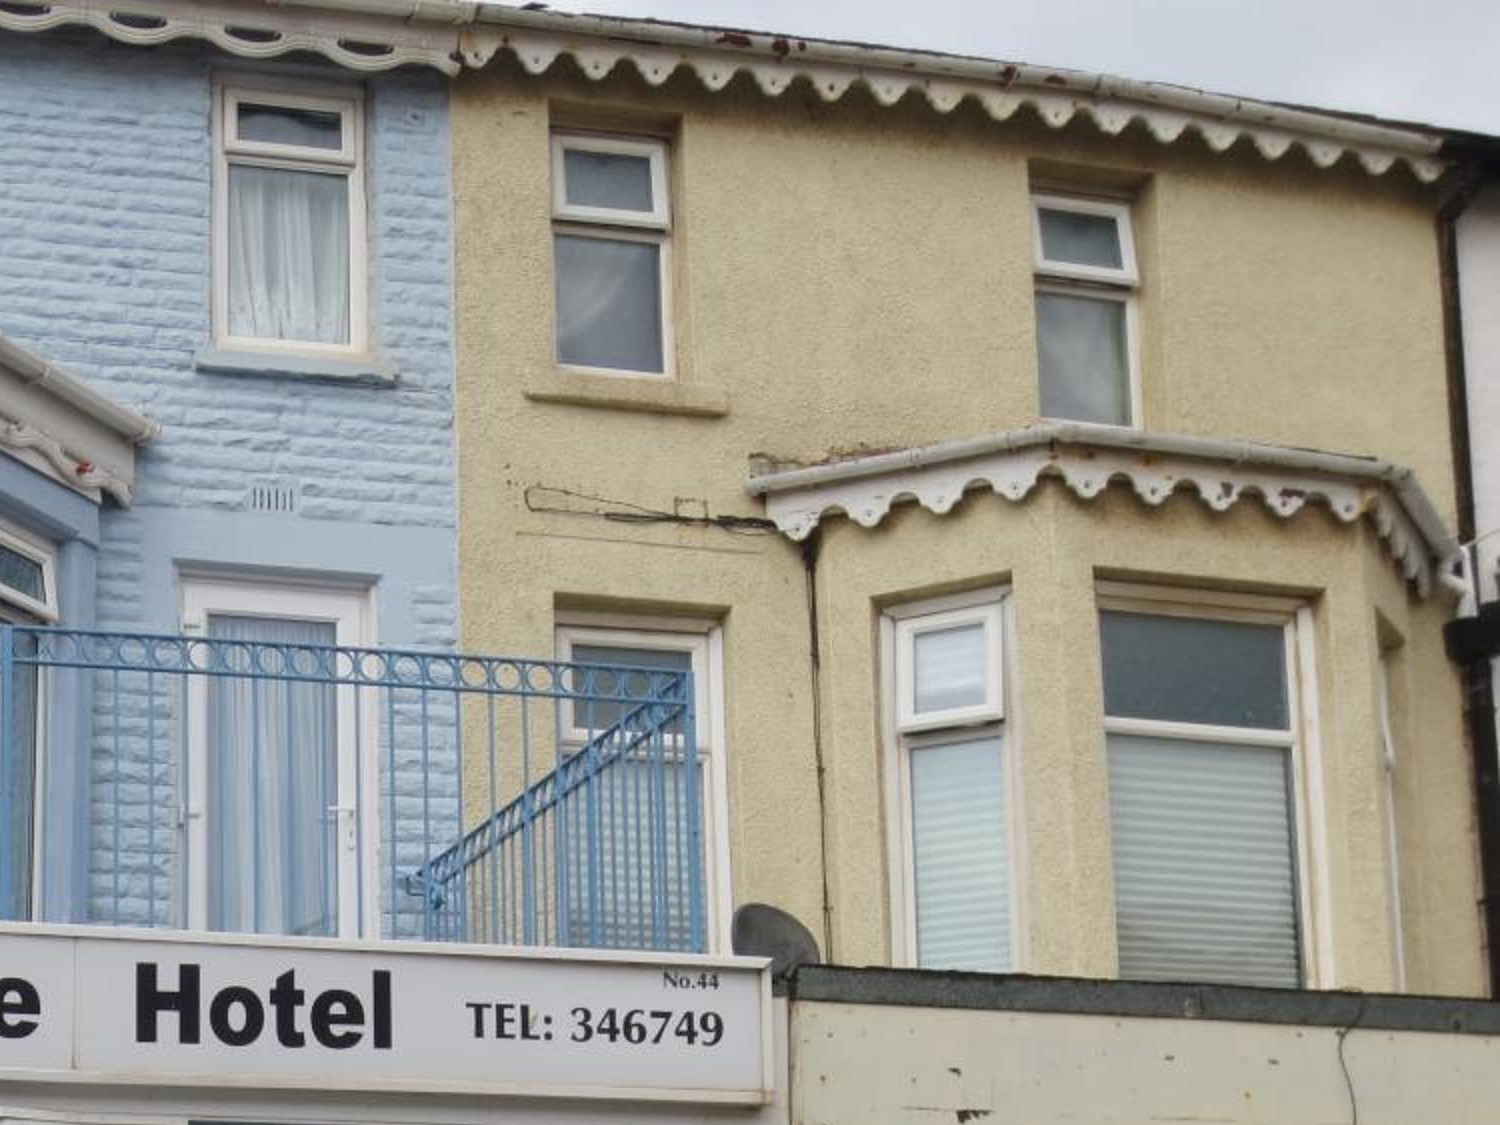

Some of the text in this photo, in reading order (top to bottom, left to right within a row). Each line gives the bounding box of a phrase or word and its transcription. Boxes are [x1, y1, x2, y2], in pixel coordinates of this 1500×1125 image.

[662, 971, 720, 990] No.44
[135, 961, 393, 1050] Hotel
[465, 1002, 725, 1047] TEL: 346749
